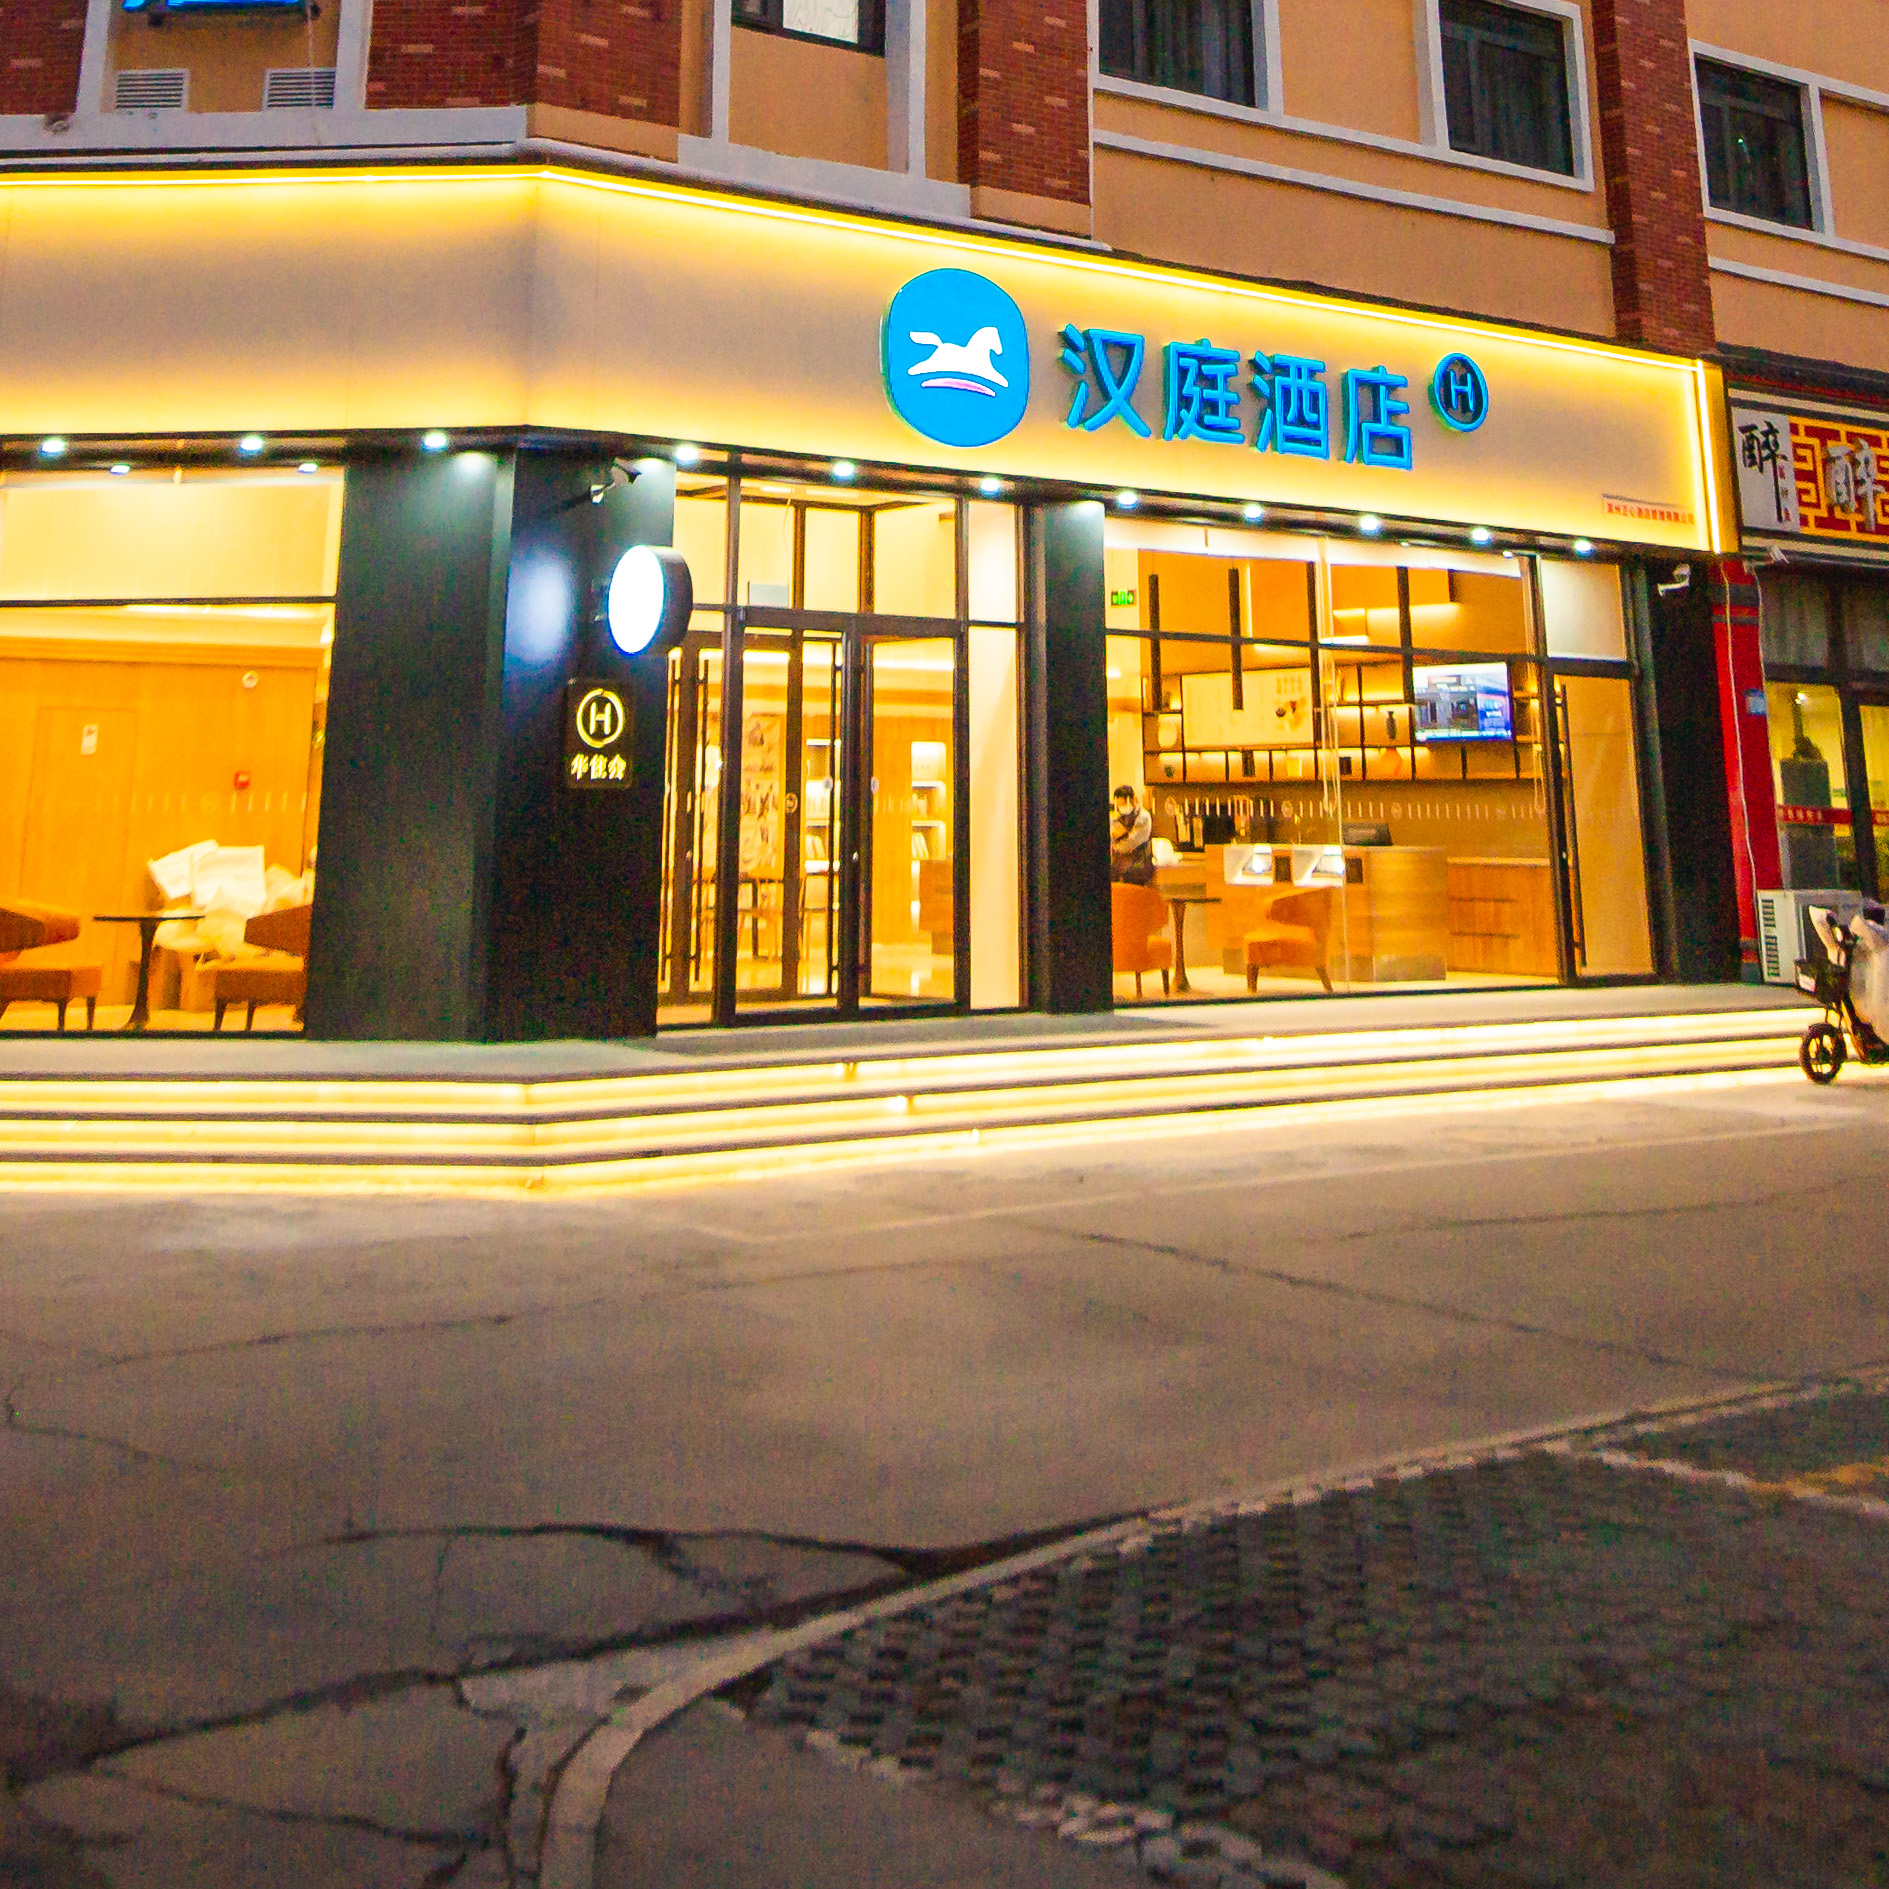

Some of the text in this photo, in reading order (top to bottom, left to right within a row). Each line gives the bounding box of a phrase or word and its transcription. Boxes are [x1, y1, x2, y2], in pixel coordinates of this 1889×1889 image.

[1058, 323, 1414, 471] 汉庭酒店
[1738, 419, 1789, 524] 醉
